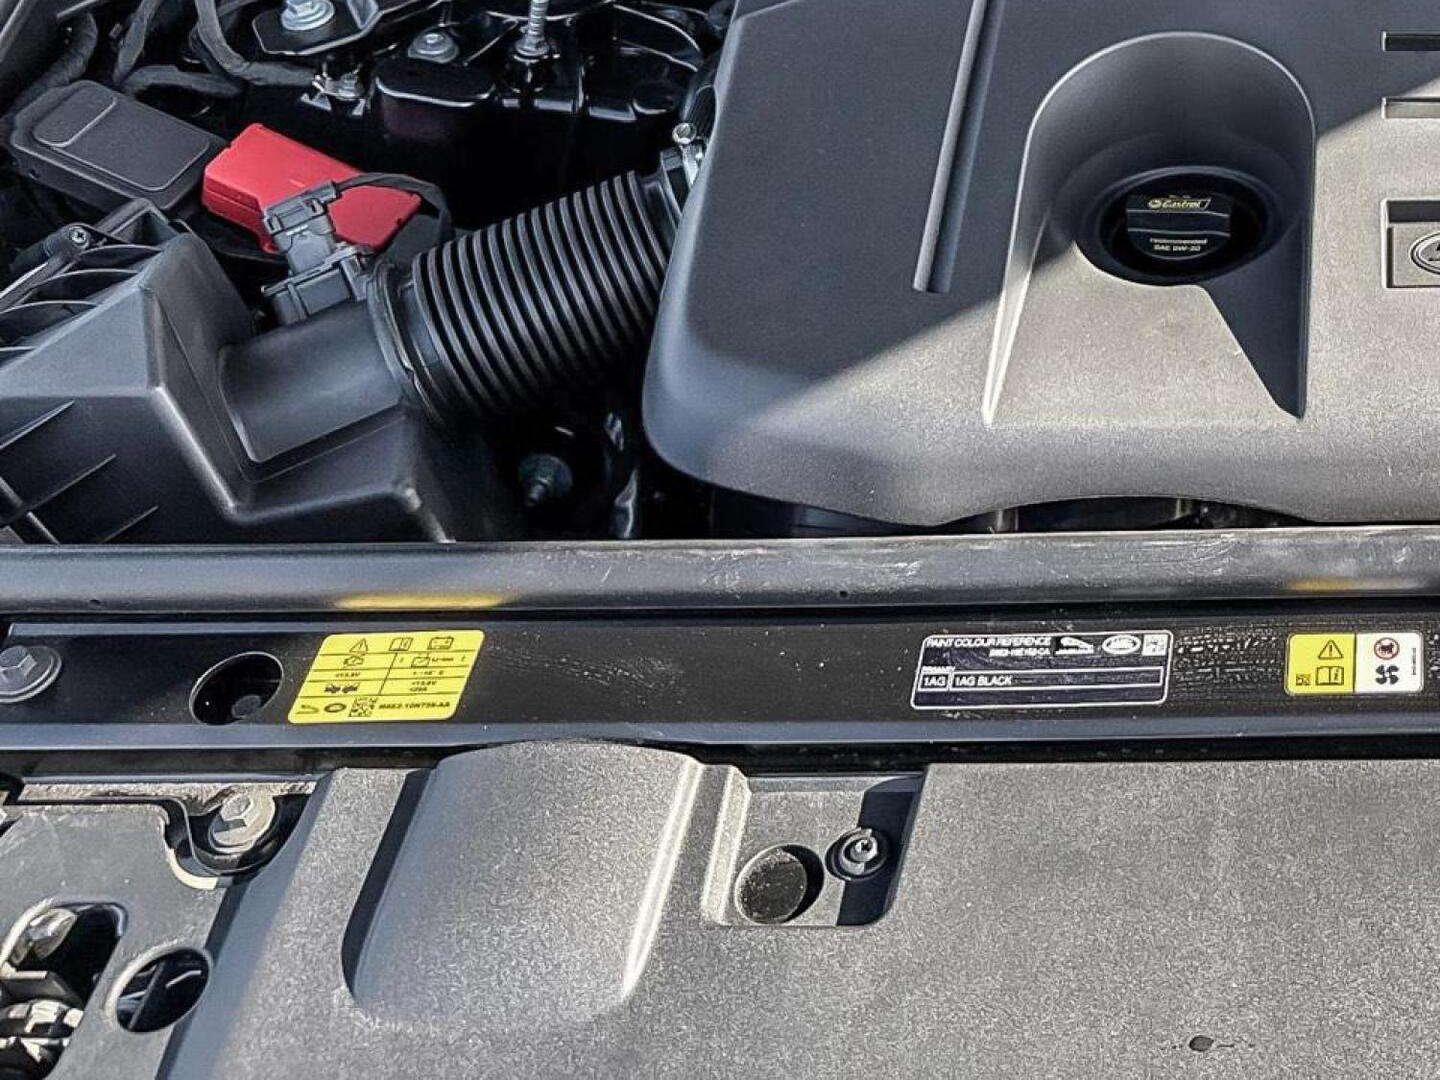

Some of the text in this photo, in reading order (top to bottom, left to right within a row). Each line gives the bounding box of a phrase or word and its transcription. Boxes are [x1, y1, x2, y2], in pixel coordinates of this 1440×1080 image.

[927, 638, 952, 647] PAINT
[955, 675, 1012, 686] 1AG BLACK
